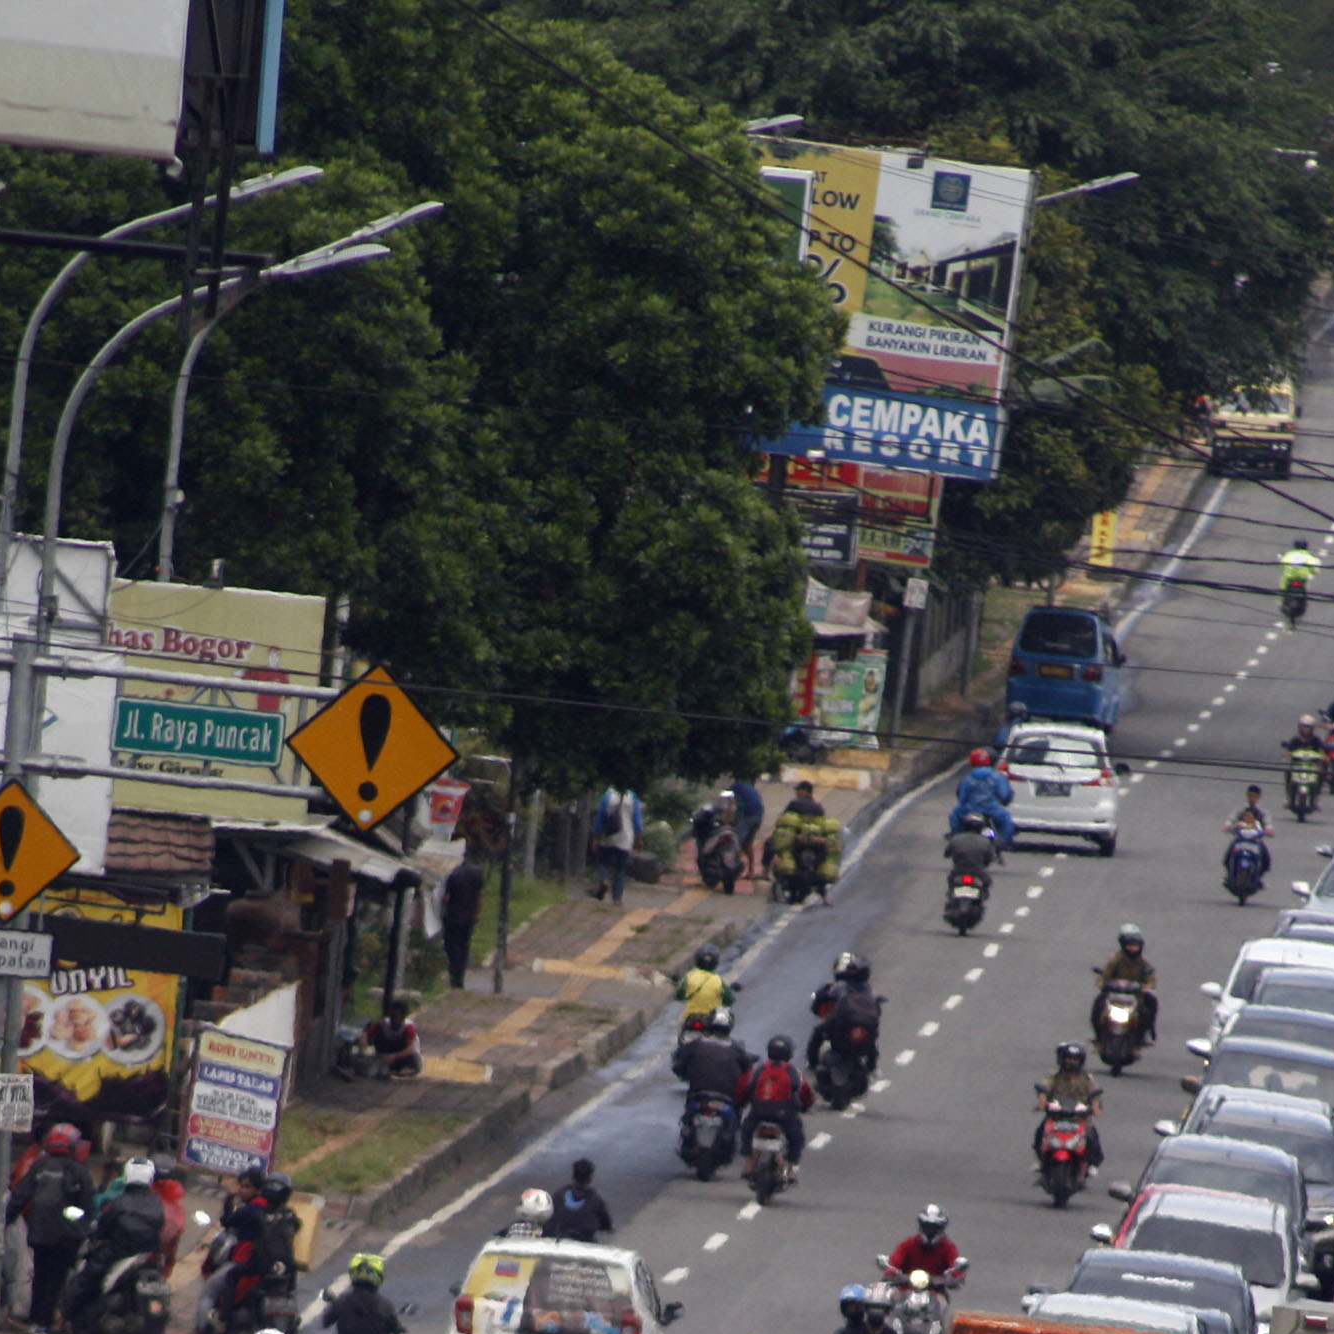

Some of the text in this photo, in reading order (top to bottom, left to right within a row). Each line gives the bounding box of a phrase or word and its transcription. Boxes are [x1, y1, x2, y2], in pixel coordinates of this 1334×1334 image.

[865, 336, 988, 362] BANYAKIN LIBURAN
[867, 321, 981, 346] KURANGI PIKIRAN
[827, 393, 991, 447] CEMPAKA
[823, 427, 990, 468] RESORT
[162, 626, 252, 664] Bogor
[122, 708, 274, 753] Jl. Raya Puncak
